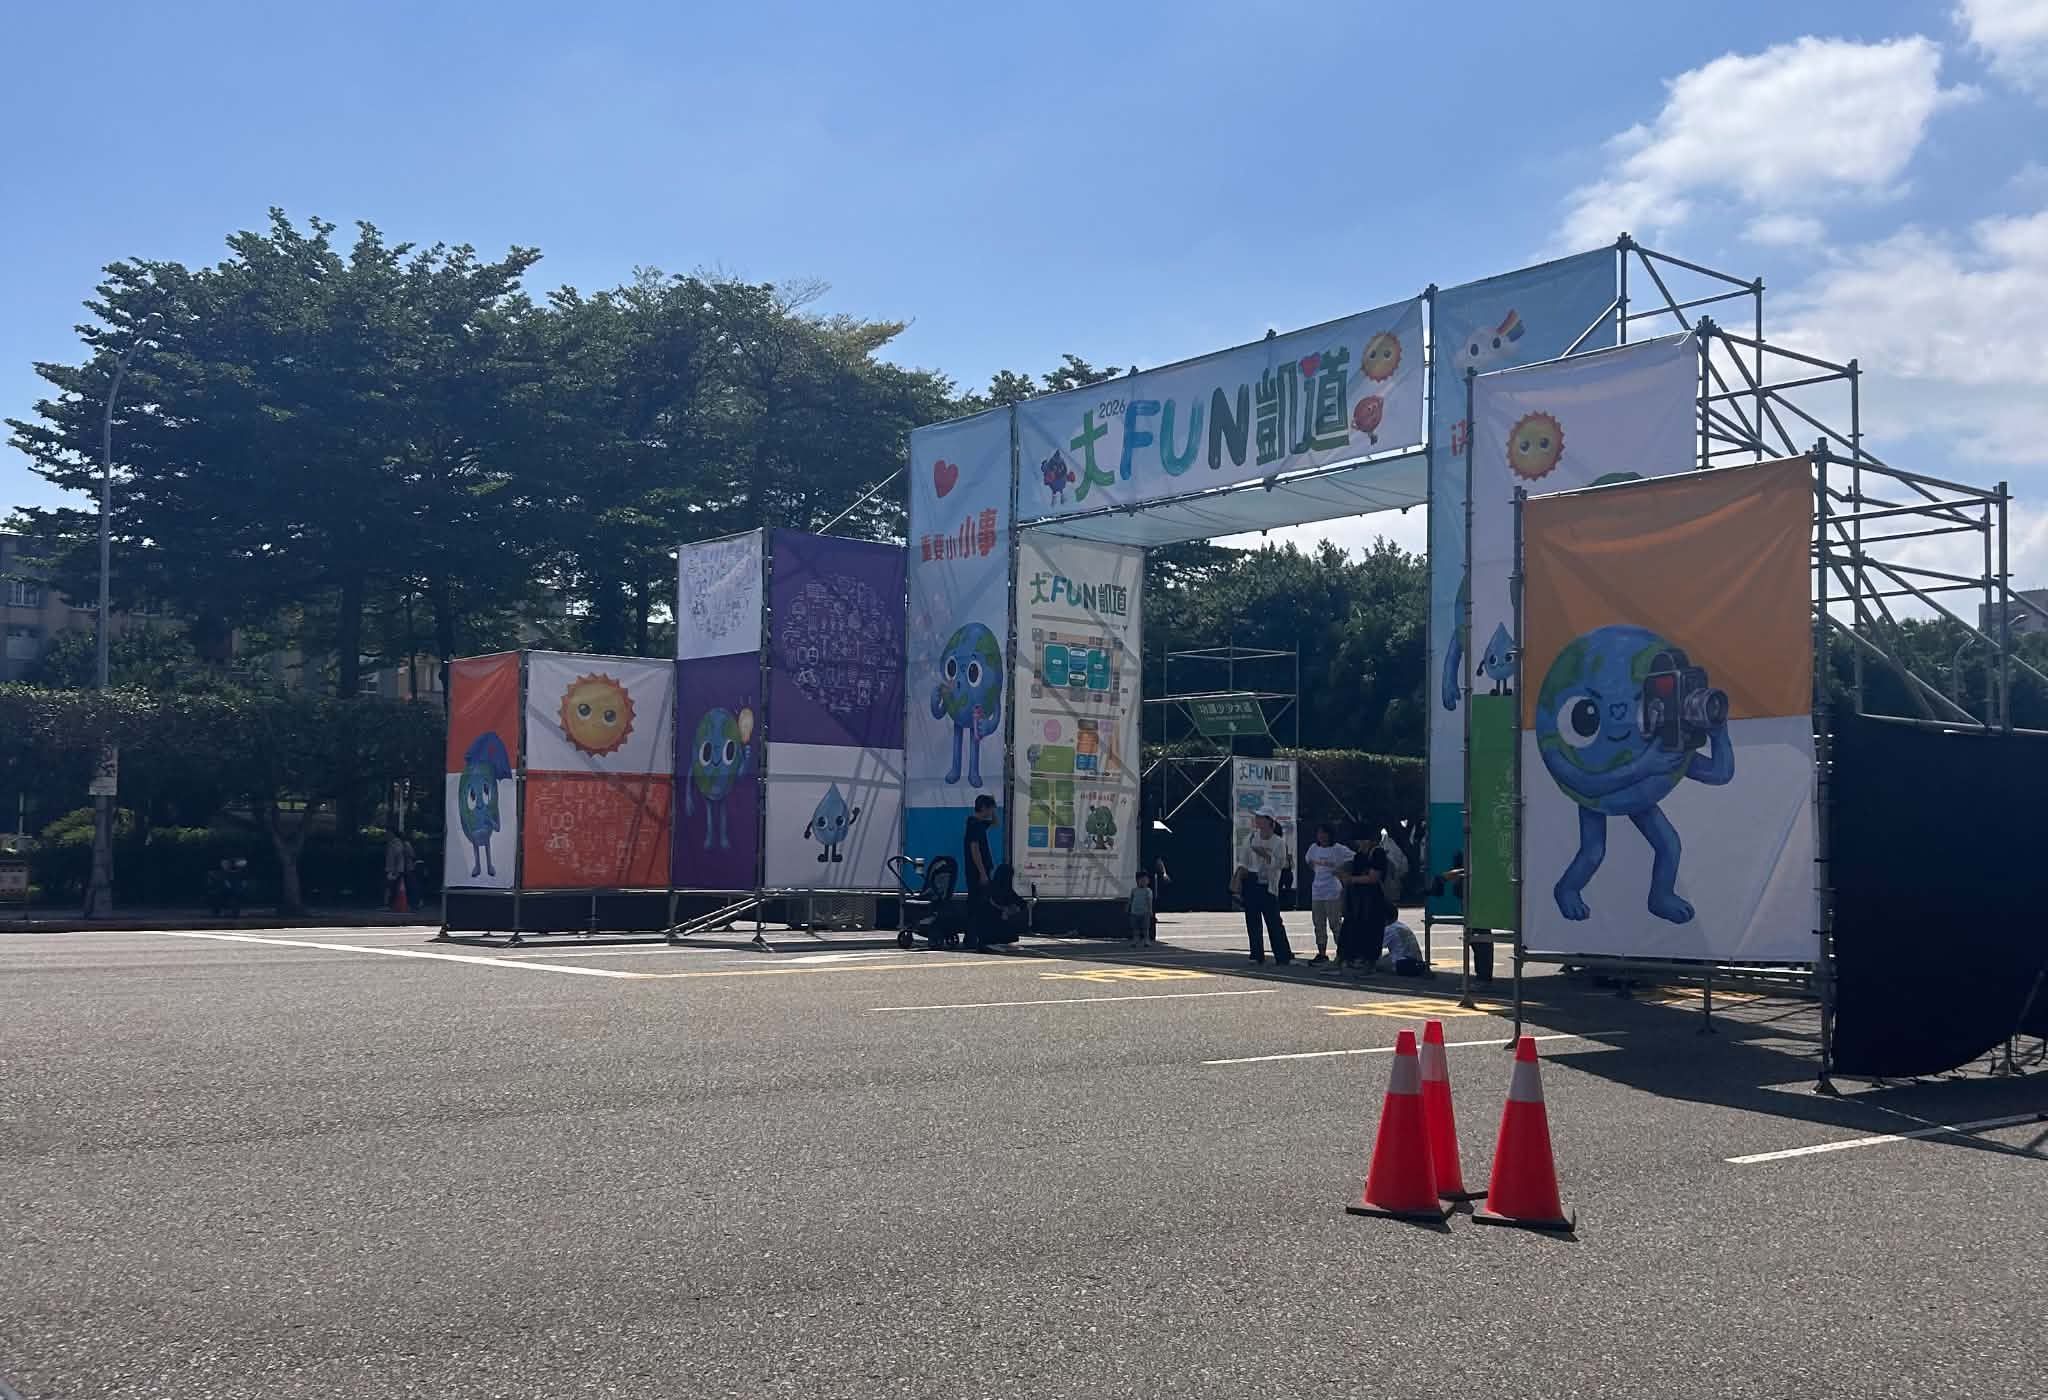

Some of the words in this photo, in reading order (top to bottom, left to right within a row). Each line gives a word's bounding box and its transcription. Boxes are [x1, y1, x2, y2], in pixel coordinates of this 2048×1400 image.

[1099, 400, 1126, 418] 2026
[920, 507, 998, 562] 重要小小事
